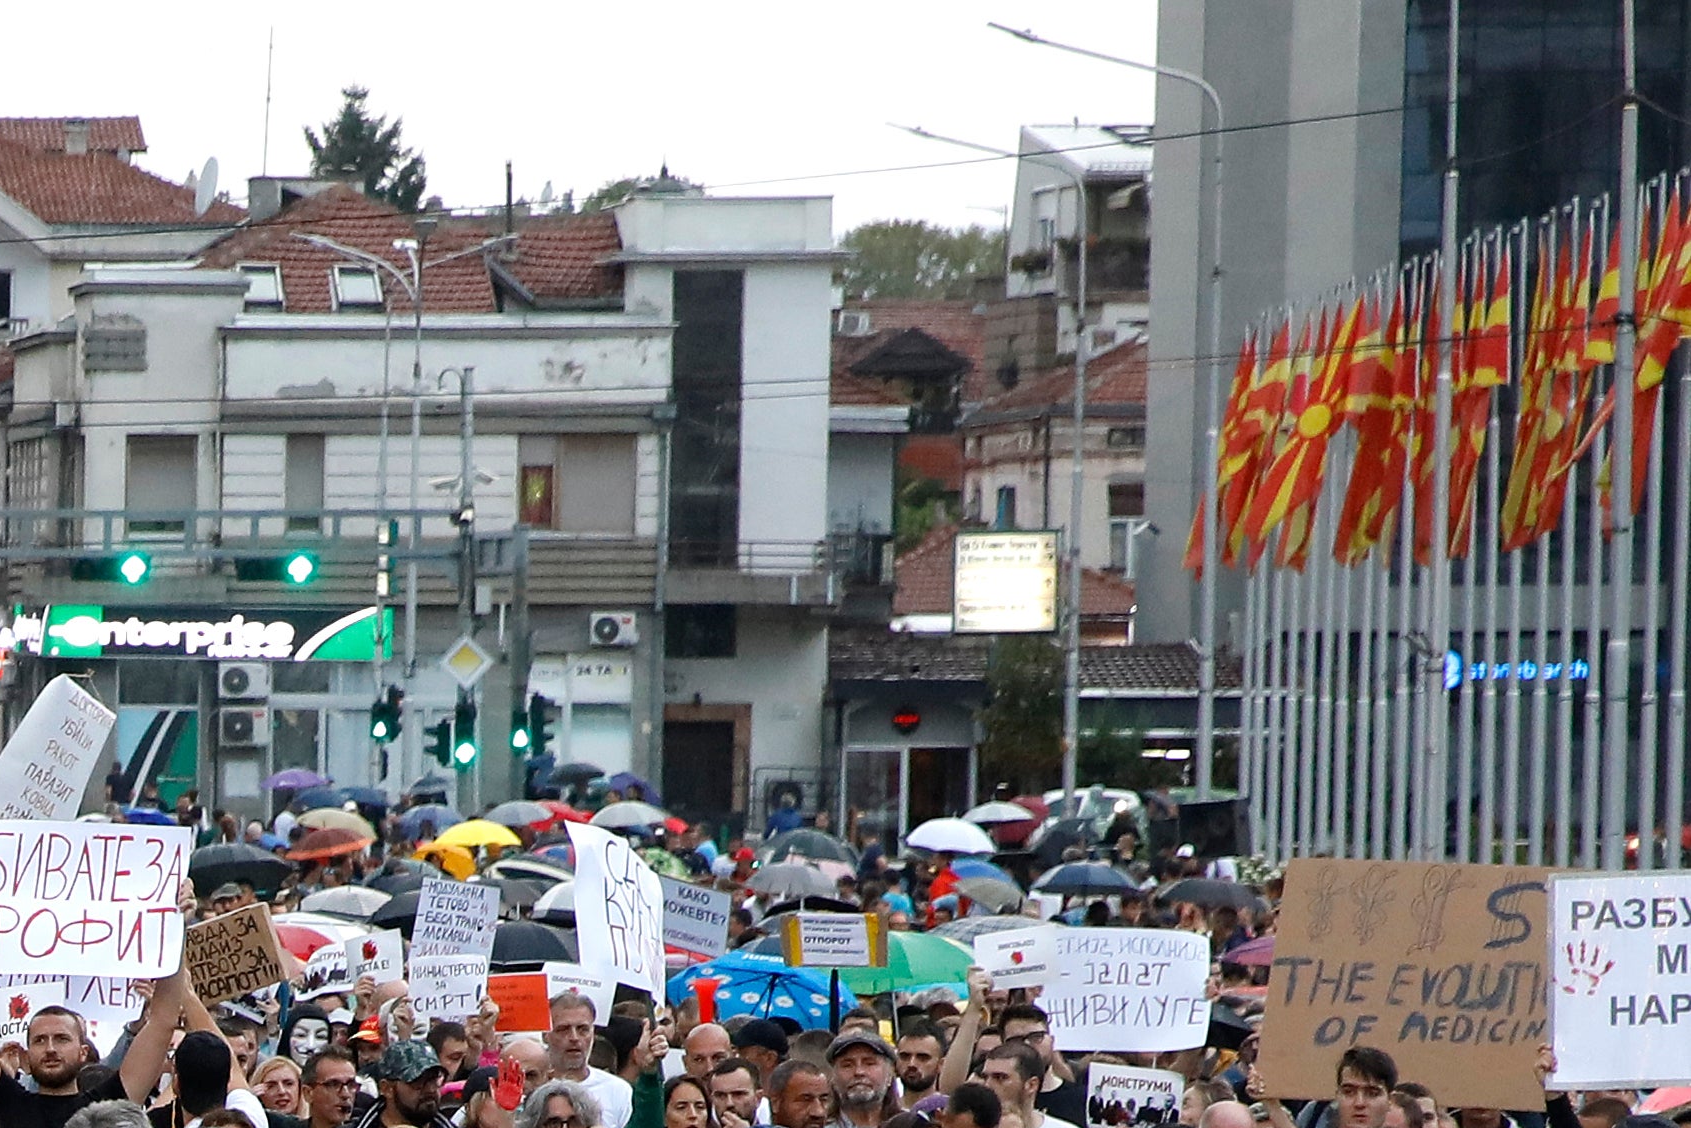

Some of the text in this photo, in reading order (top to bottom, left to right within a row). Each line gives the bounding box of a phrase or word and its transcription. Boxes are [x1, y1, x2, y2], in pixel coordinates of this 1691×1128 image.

[44, 739, 80, 771] РАКОТ
[24, 762, 76, 802] ПАРАЗИТ
[20, 785, 57, 818] КОВИД
[137, 838, 182, 909] ЗА
[678, 886, 710, 905] КАКО
[186, 914, 258, 948] АВДА ЗА
[804, 936, 850, 945] ОТПОРОТ
[186, 936, 244, 963] ИЛАИЗ
[189, 945, 269, 982] АТВОР ЗА
[412, 962, 486, 979] МИНИСТЕРСТВО
[1273, 956, 1374, 1007] THE
[1314, 1014, 1378, 1047] OF
[1101, 1075, 1173, 1093] МОНСТРУМИ
